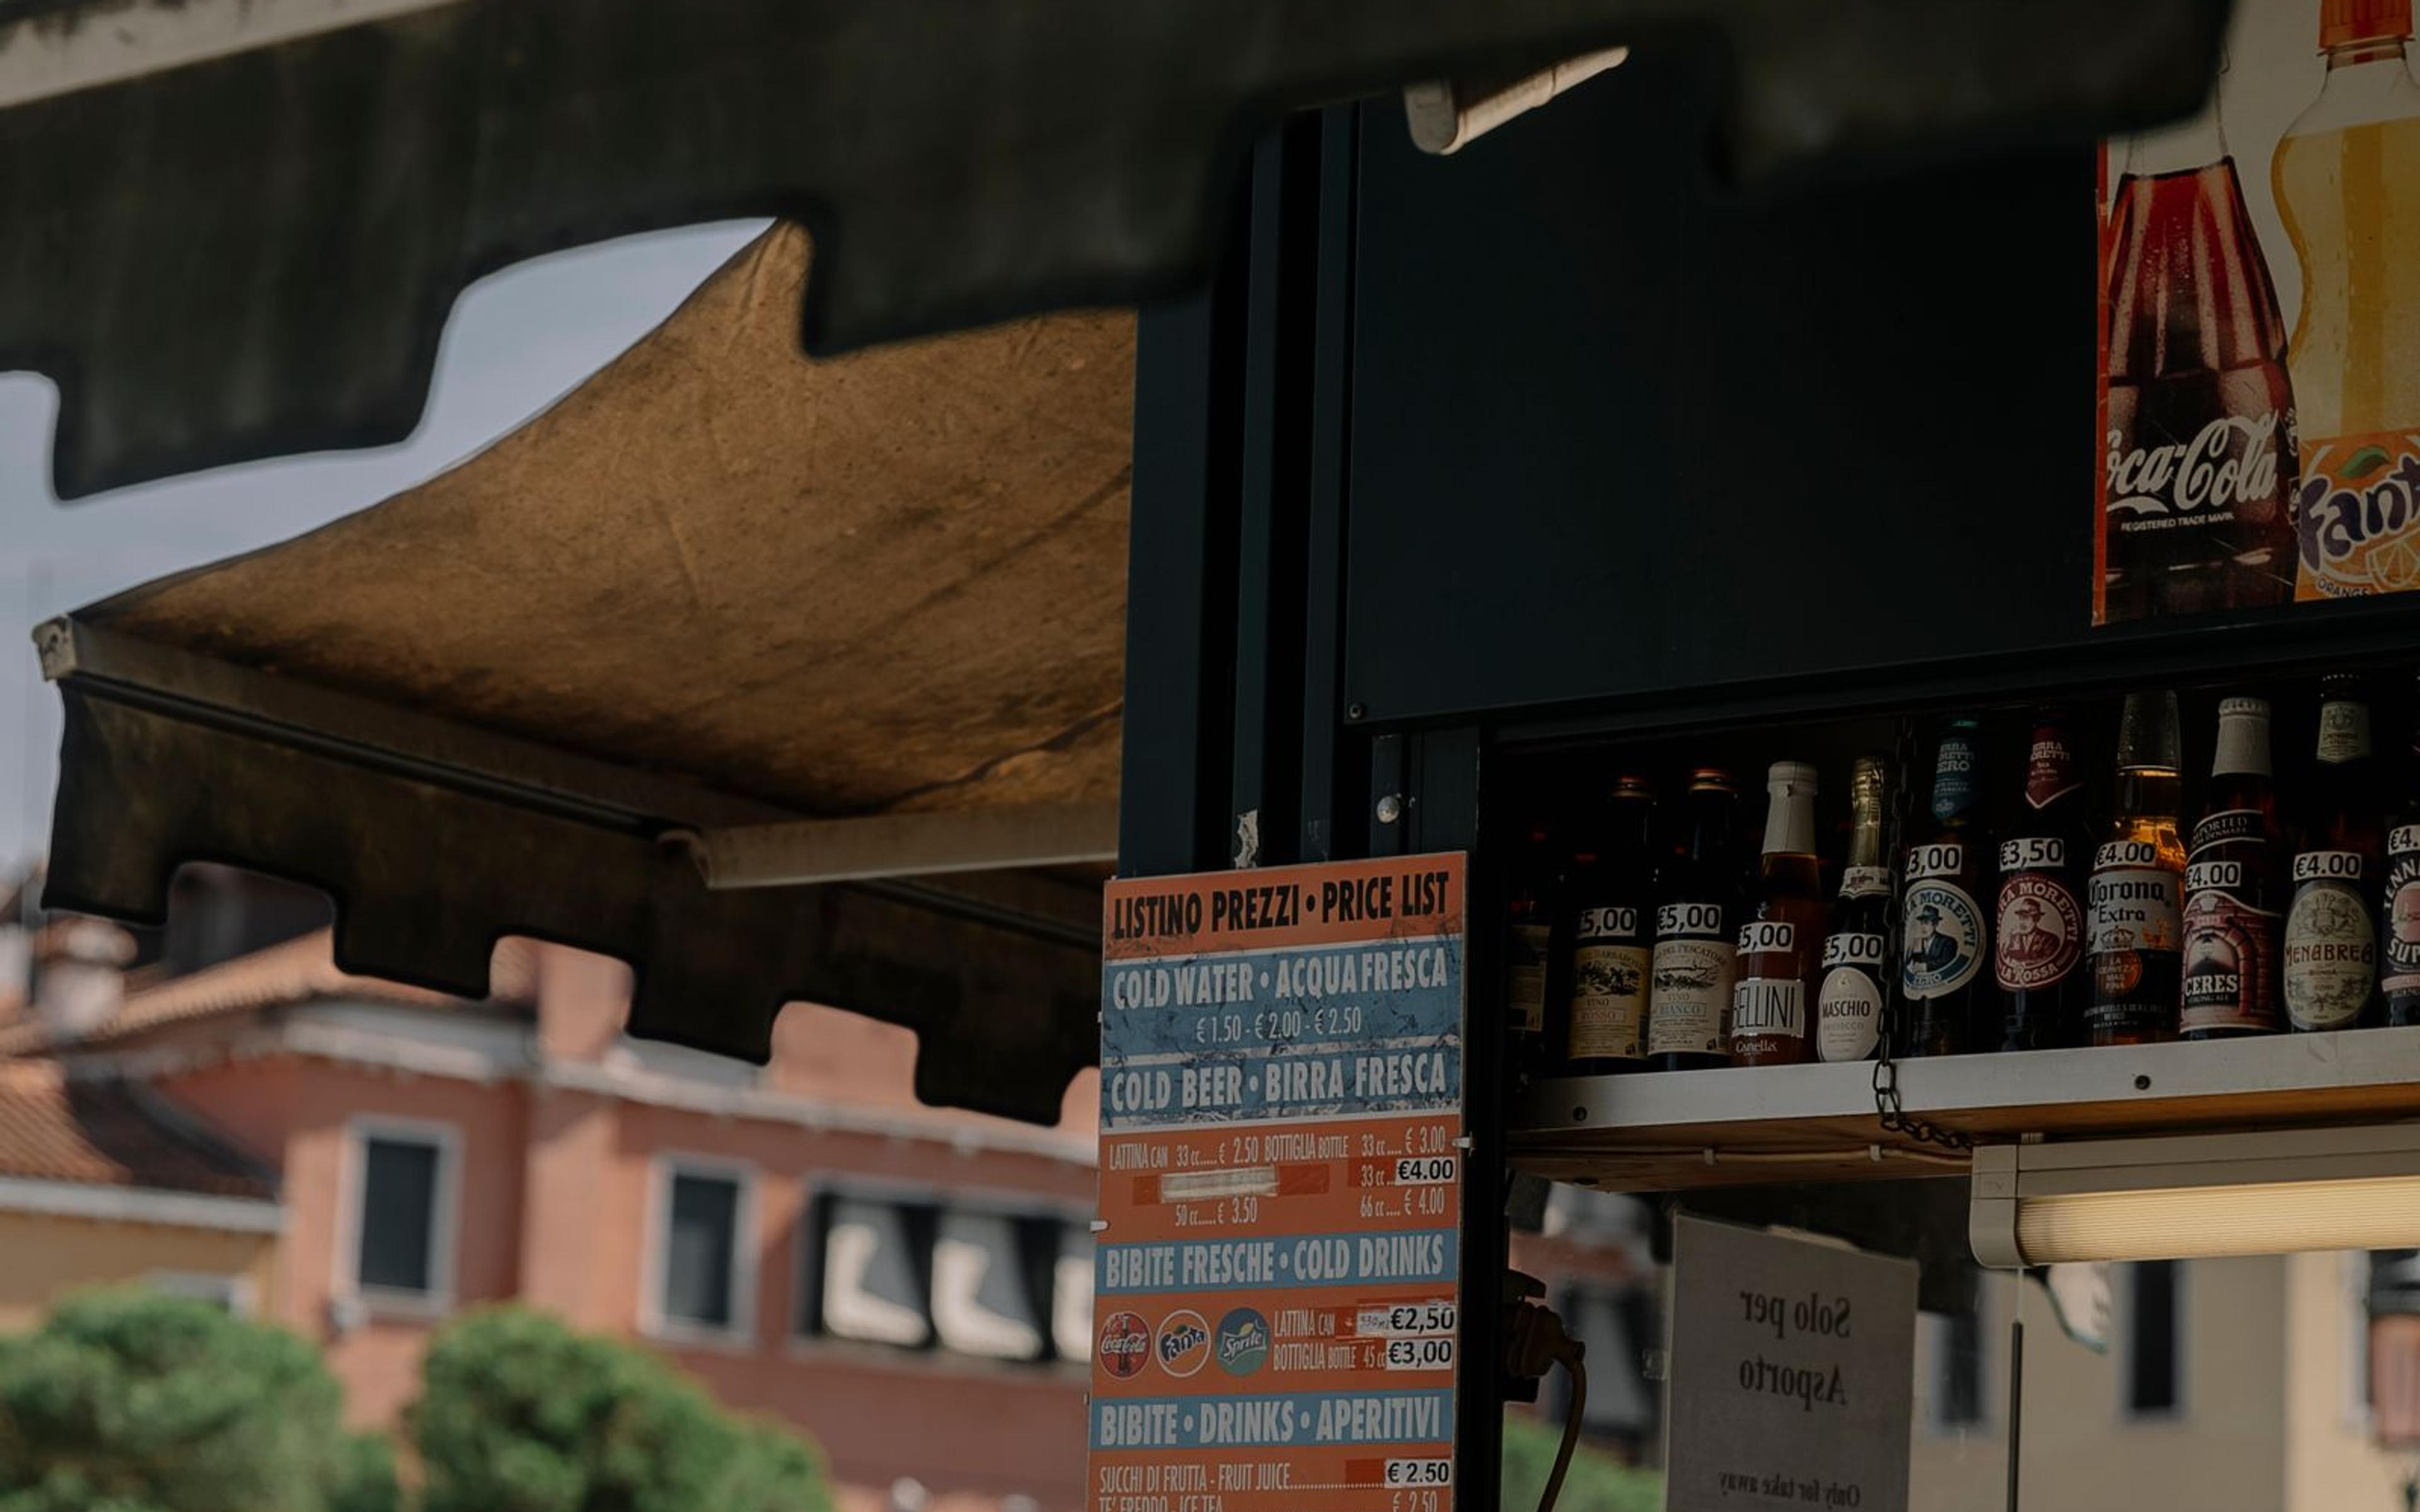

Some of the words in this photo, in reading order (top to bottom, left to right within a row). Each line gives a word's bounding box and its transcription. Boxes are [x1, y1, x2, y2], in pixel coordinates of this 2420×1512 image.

[2121, 518, 2176, 532] REGISTERED
[2178, 514, 2206, 527] TRADE
[2208, 511, 2235, 523] MARK
[1906, 847, 1959, 874] 3,00
[2001, 839, 2063, 867] €3,50
[2097, 842, 2154, 865] €4.00
[2295, 854, 2360, 876] €4.00
[2187, 864, 2238, 886] €4.00
[2383, 857, 2420, 908] TENN
[1113, 893, 1202, 939] LISTINO
[1212, 885, 1299, 932] PREZZI
[1323, 876, 1392, 924] PRICE
[1402, 871, 1449, 916] LIST
[2087, 880, 2164, 911] Corona
[1575, 909, 1635, 936] 5,00
[1658, 906, 1719, 932] €5,00
[1920, 891, 1976, 947] MORETTI
[2020, 882, 2078, 942] MORETTI
[2099, 905, 2145, 924] Extra
[1738, 924, 1792, 951] 5,00
[2285, 942, 2373, 966] MENABREA
[1113, 968, 1171, 1009] COLD
[1173, 963, 1254, 1005] WATER
[1274, 953, 1361, 1000] ACQUA
[1361, 948, 1448, 992] FRESCA
[2185, 974, 2238, 997] CERES
[1211, 1014, 1242, 1043] 1.50
[1269, 1010, 1301, 1040] 2.00
[1329, 1005, 1362, 1035] 2.50
[1111, 1070, 1172, 1113] COLD
[1181, 1066, 1243, 1109] BEER
[1265, 1059, 1345, 1103] BIRRA
[1354, 1053, 1447, 1097] FRESCA
[1109, 1143, 1149, 1171] LATTINA
[1150, 1145, 1169, 1169] CAN
[1176, 1144, 1189, 1167] 33
[1233, 1136, 1259, 1164] 2.50
[1264, 1133, 1316, 1162] BOTTIGLIA
[1317, 1135, 1349, 1160] BOTTLE
[1361, 1133, 1374, 1157] 33
[1419, 1125, 1446, 1154] 3.00
[1361, 1164, 1374, 1188] 33
[1398, 1160, 1453, 1181] €4.00
[1232, 1197, 1258, 1224] 3.50
[1418, 1187, 1445, 1215] 4.00
[1105, 1246, 1175, 1288] BIBITE
[1180, 1240, 1275, 1286] FRESCHE
[1294, 1238, 1351, 1281] COLD
[1358, 1234, 1444, 1278] DRINKS
[1274, 1309, 1316, 1337] LATTINA
[1318, 1312, 1335, 1337] CAN
[1391, 1307, 1455, 1333] €2,50
[1160, 1326, 1207, 1363] Fanta
[1222, 1327, 1264, 1360] Sprite
[1273, 1343, 1326, 1372] BOTTIGLIA
[1328, 1346, 1357, 1369] BOTTLE
[1388, 1340, 1452, 1368] €3,00
[1100, 1403, 1178, 1446] BIBITE
[1199, 1399, 1294, 1444] DRINKS
[1315, 1396, 1441, 1441] APERITIVI
[1099, 1465, 1143, 1494] SUCCHI
[1146, 1465, 1159, 1493] DI
[1163, 1464, 1207, 1492] FRUTTA
[1218, 1463, 1254, 1491] FRUIT
[1406, 1462, 1449, 1483] 2.50
[1121, 1495, 1167, 1512] FREDDO
[1179, 1495, 1199, 1512] ICE
[1203, 1494, 1223, 1512] TEA
[1409, 1490, 1438, 1512] 250
